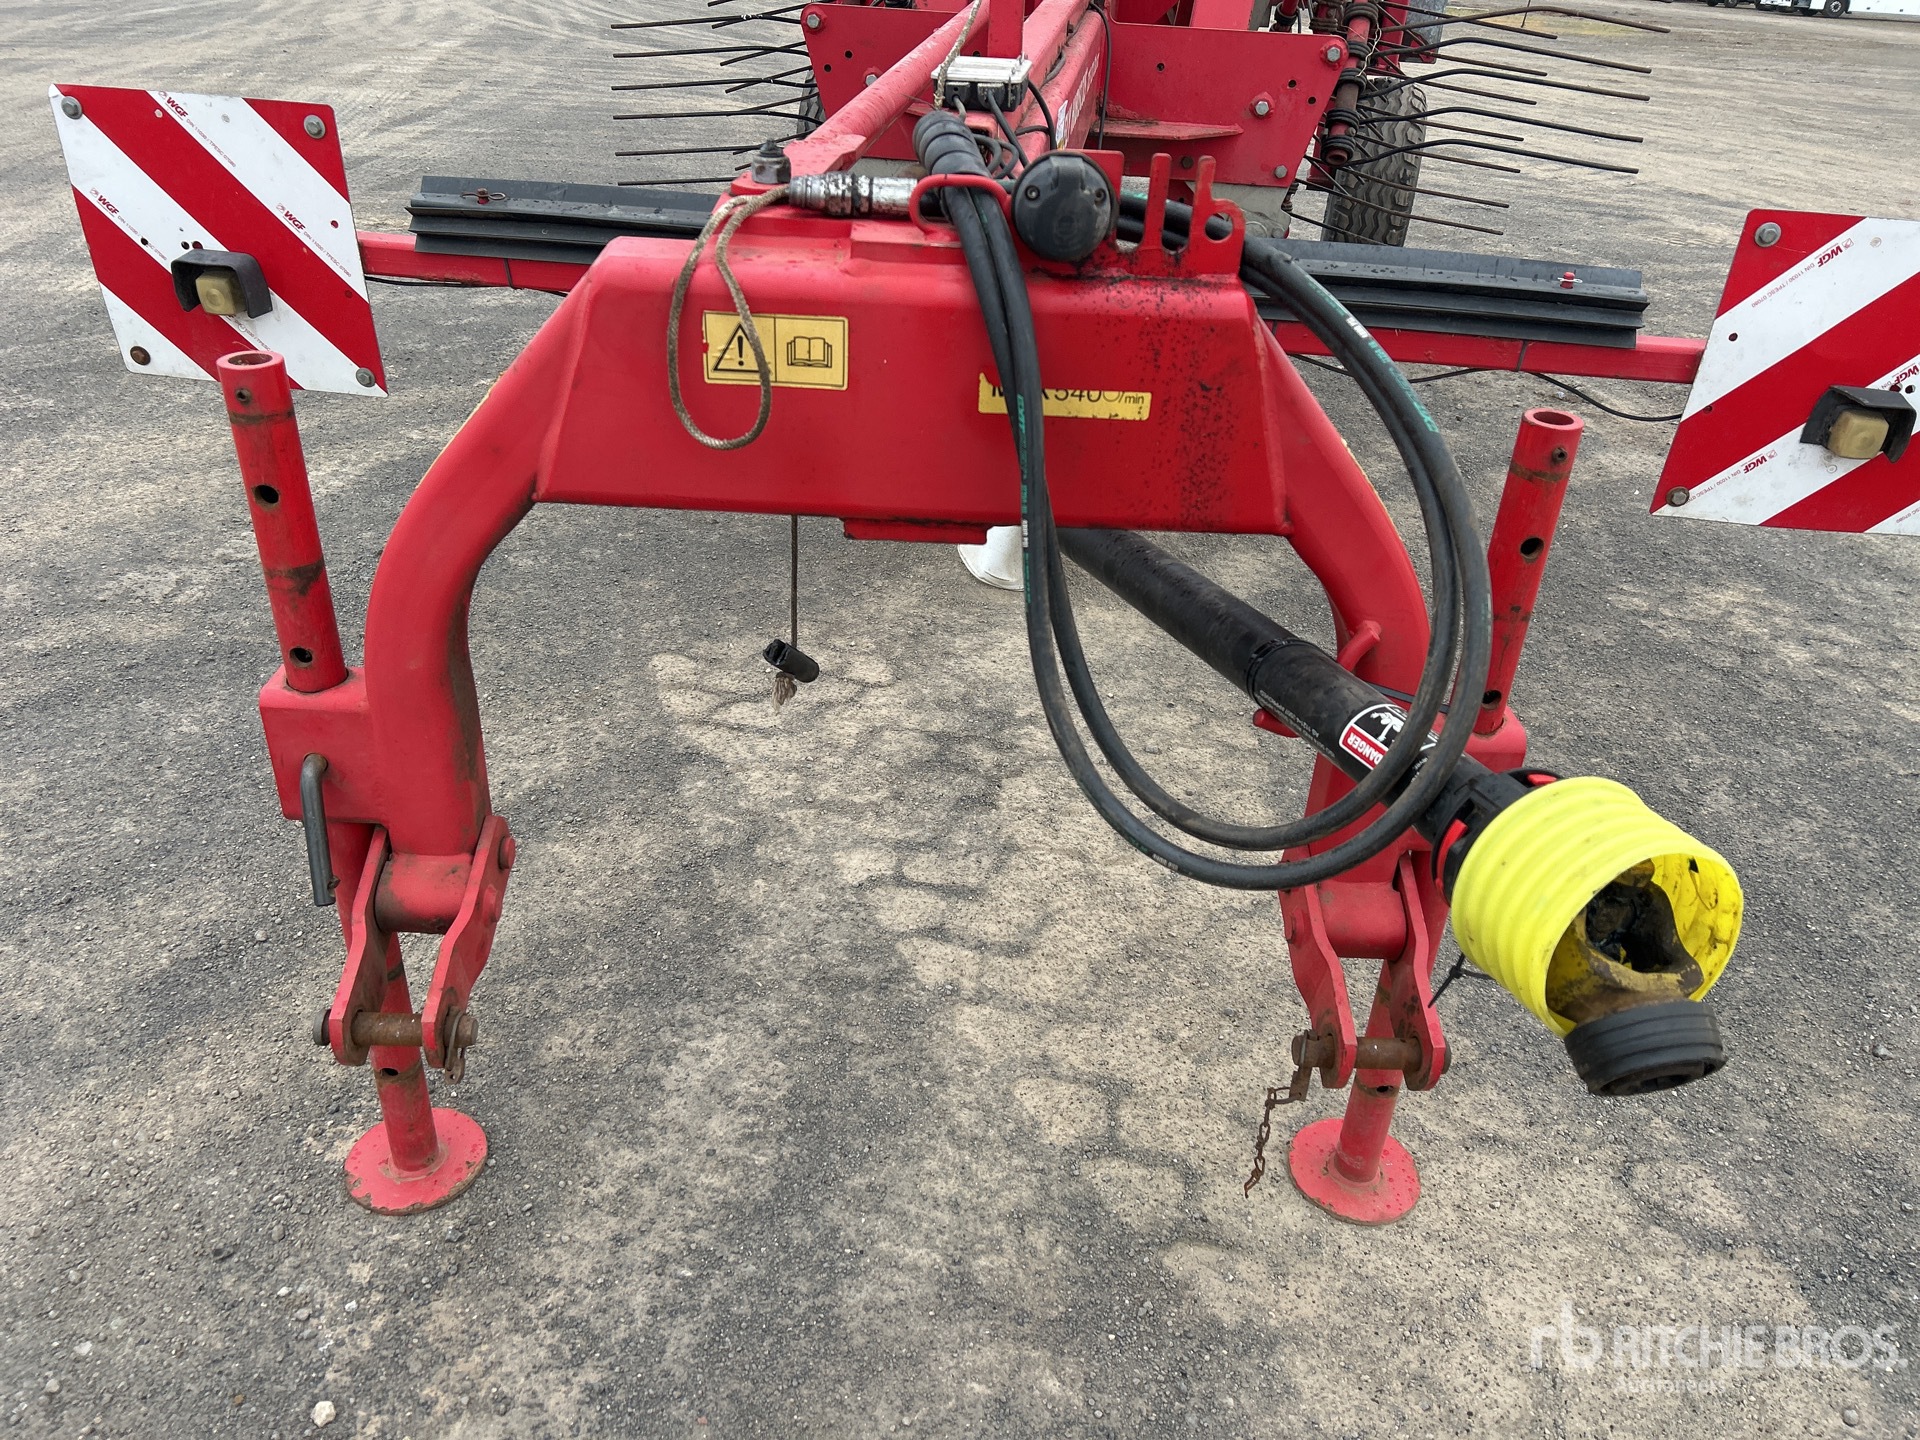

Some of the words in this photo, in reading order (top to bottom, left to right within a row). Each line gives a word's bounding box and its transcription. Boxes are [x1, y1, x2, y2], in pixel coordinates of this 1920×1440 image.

[166, 96, 189, 117] WGF
[98, 195, 120, 214] WGF
[284, 210, 306, 230] WGF
[1817, 245, 1843, 268] WGF
[1895, 364, 1920, 385] WGF
[1743, 455, 1768, 474] WGF
[1347, 732, 1384, 765] DANGER
